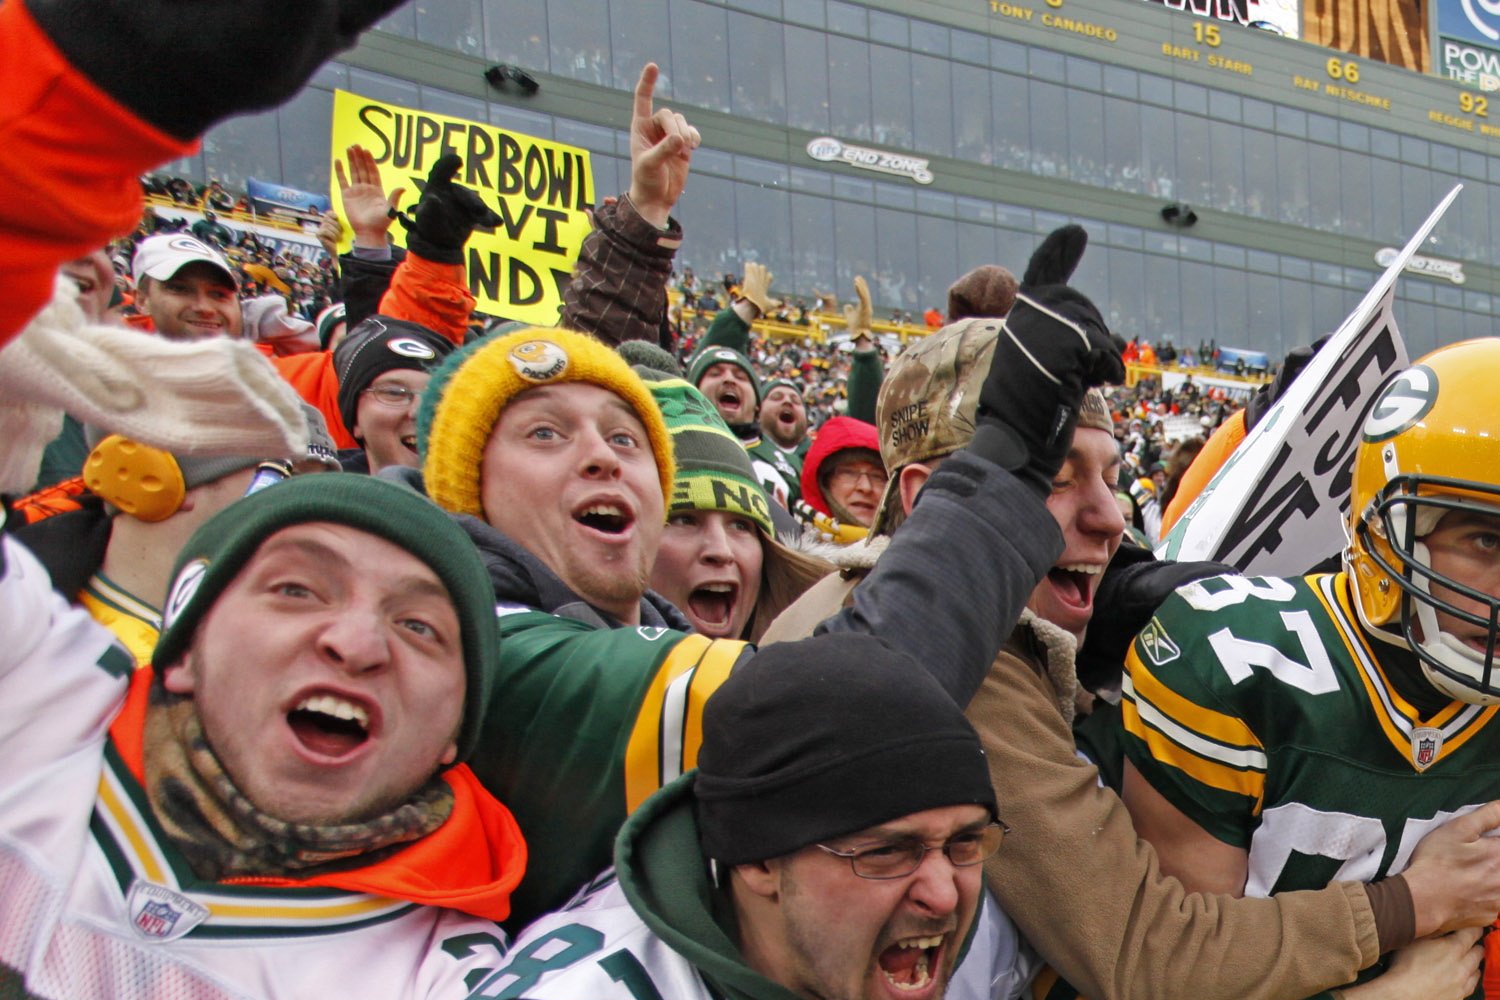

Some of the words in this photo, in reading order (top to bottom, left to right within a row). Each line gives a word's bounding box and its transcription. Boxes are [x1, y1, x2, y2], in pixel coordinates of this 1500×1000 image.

[990, 1, 1033, 20] TONY
[1042, 14, 1117, 41] CANADEO
[1193, 22, 1221, 47] 15
[1162, 43, 1200, 61] BART
[1208, 54, 1252, 75] STARR
[1327, 57, 1360, 83] 66
[1447, 65, 1477, 84] THE
[1294, 76, 1319, 91] RAY
[1325, 83, 1391, 110] NITSCHKE
[1459, 91, 1488, 117] 92
[1428, 110, 1474, 131] REGGIE
[842, 149, 878, 164] END
[521, 358, 566, 380] PACKERS
[891, 399, 930, 428] SNIPE
[891, 417, 931, 448] SHOW
